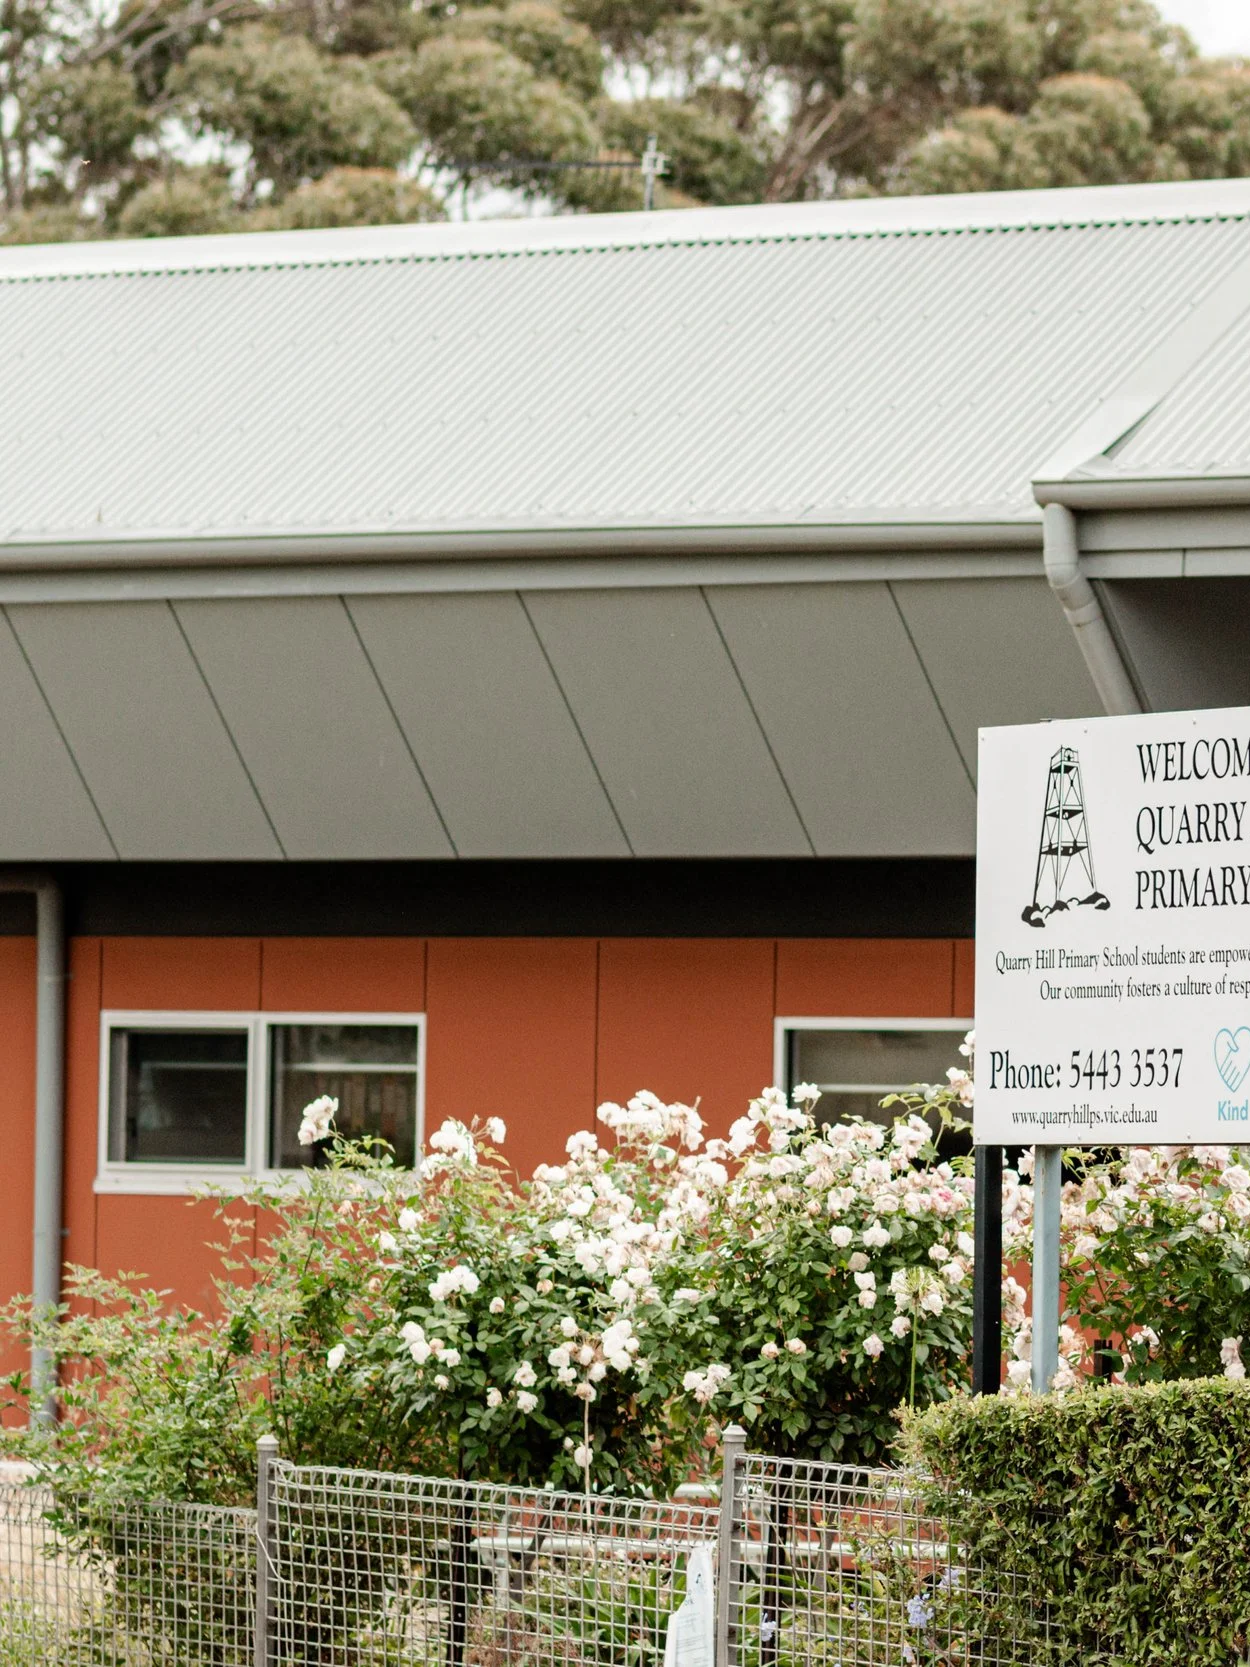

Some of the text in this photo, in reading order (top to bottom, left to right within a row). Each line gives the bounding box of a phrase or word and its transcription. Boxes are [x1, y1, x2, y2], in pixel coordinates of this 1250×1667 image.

[1136, 801, 1247, 854] QUARRY
[995, 950, 1032, 975] Quarry
[1035, 949, 1055, 969] Hill
[1058, 948, 1099, 971] Primary
[1103, 945, 1139, 967] School
[1141, 944, 1186, 965] students
[1189, 949, 1206, 964] are
[1040, 980, 1061, 1000] Our
[1064, 979, 1123, 1002] community
[1127, 976, 1161, 997] fosters
[1164, 984, 1170, 996] a
[1173, 975, 1212, 996] culture
[1215, 973, 1228, 994] of
[989, 1048, 1183, 1090] Phone: 5443 3537
[1011, 1104, 1158, 1129] www.quarryhillps.vic.edu.au
[1217, 1099, 1249, 1121] Kind
